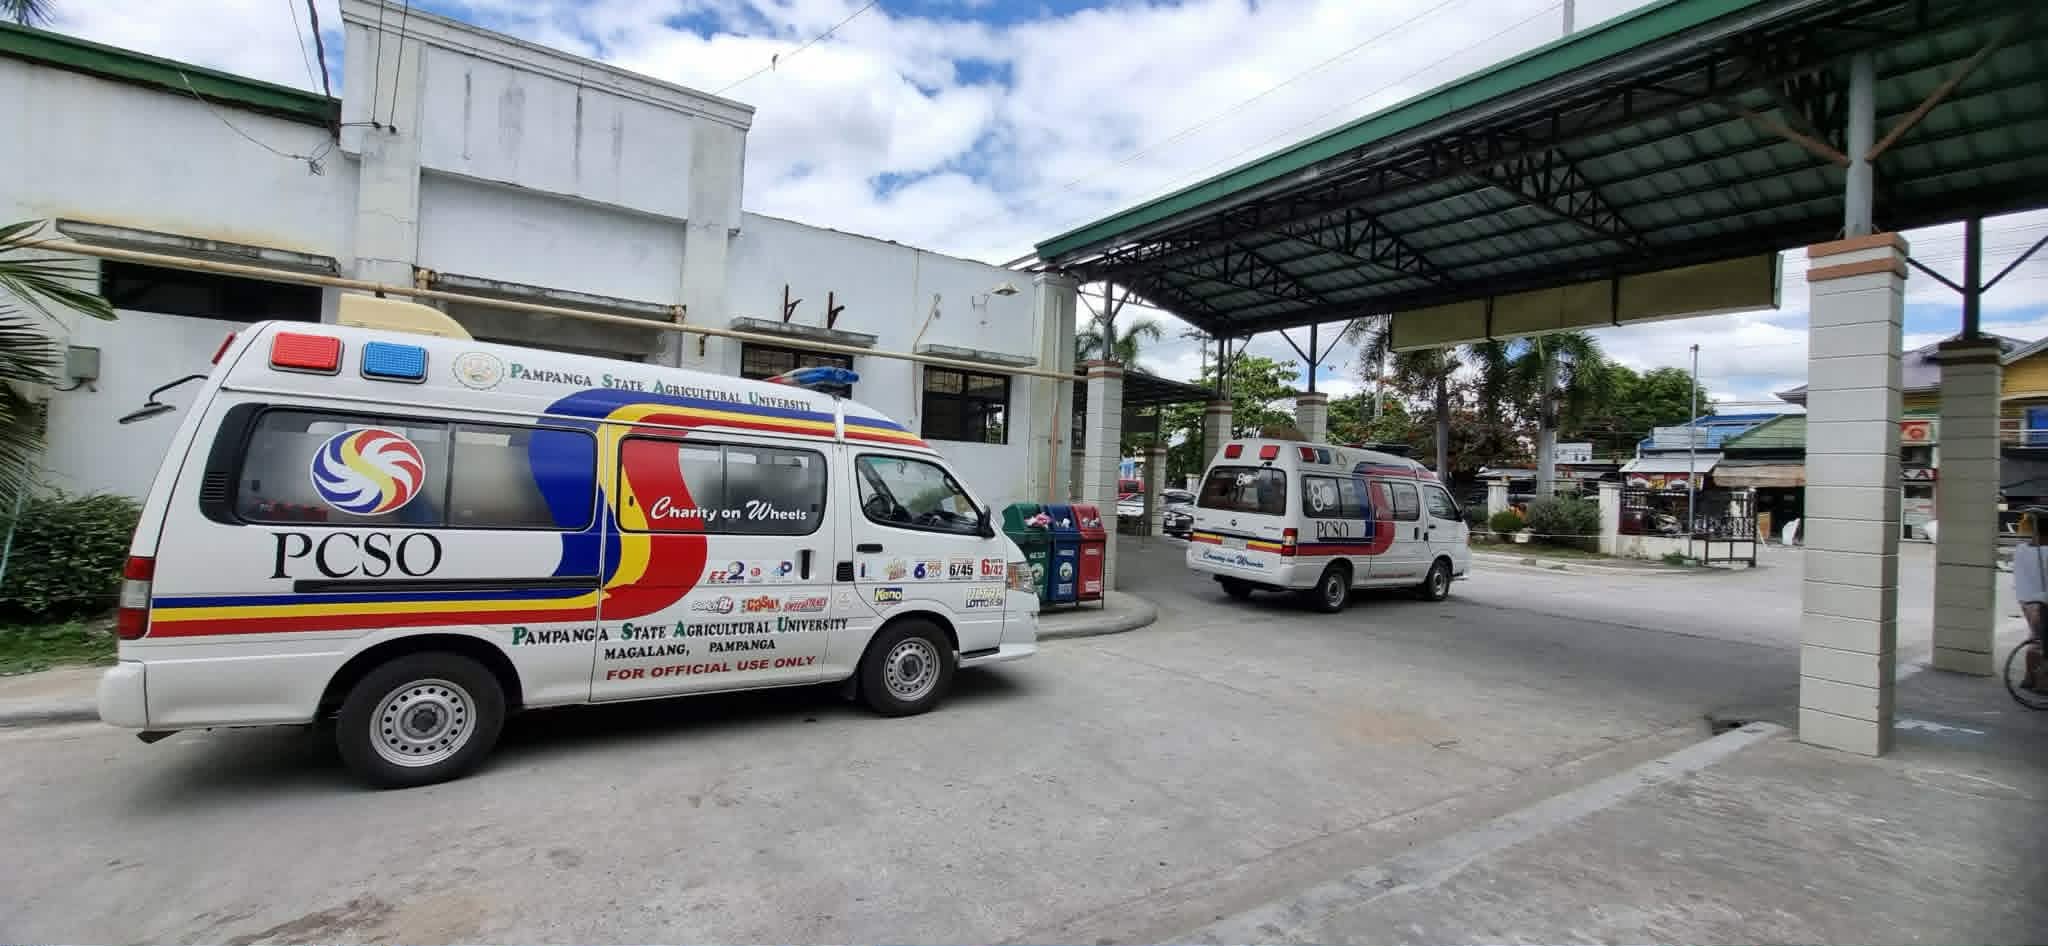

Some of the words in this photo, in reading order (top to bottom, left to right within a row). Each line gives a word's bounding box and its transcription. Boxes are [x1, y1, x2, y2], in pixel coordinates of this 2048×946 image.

[510, 363, 592, 387] PAMPANGA
[602, 373, 644, 392] STATE
[653, 379, 742, 403] AGRICULTURAL
[748, 391, 812, 411] UNIVERSITY
[651, 496, 717, 521] Charity
[721, 508, 741, 519] on
[745, 500, 808, 520] Wheels
[1315, 520, 1349, 538] PCSO
[269, 532, 442, 579] PCSO
[950, 564, 974, 576] 6/45
[875, 588, 902, 601] Keno
[512, 626, 609, 645] PAMPANGA
[621, 623, 667, 640] STATE
[673, 620, 771, 637] AGRICULTURAL
[777, 616, 848, 632] UNIVERSITY
[604, 644, 690, 660] MAGALANG,
[709, 639, 776, 653] PAMPANGA
[606, 668, 645, 681] FOR
[651, 661, 731, 679] OFFICIAL
[737, 659, 769, 671] USE
[774, 656, 816, 668] ONLY
